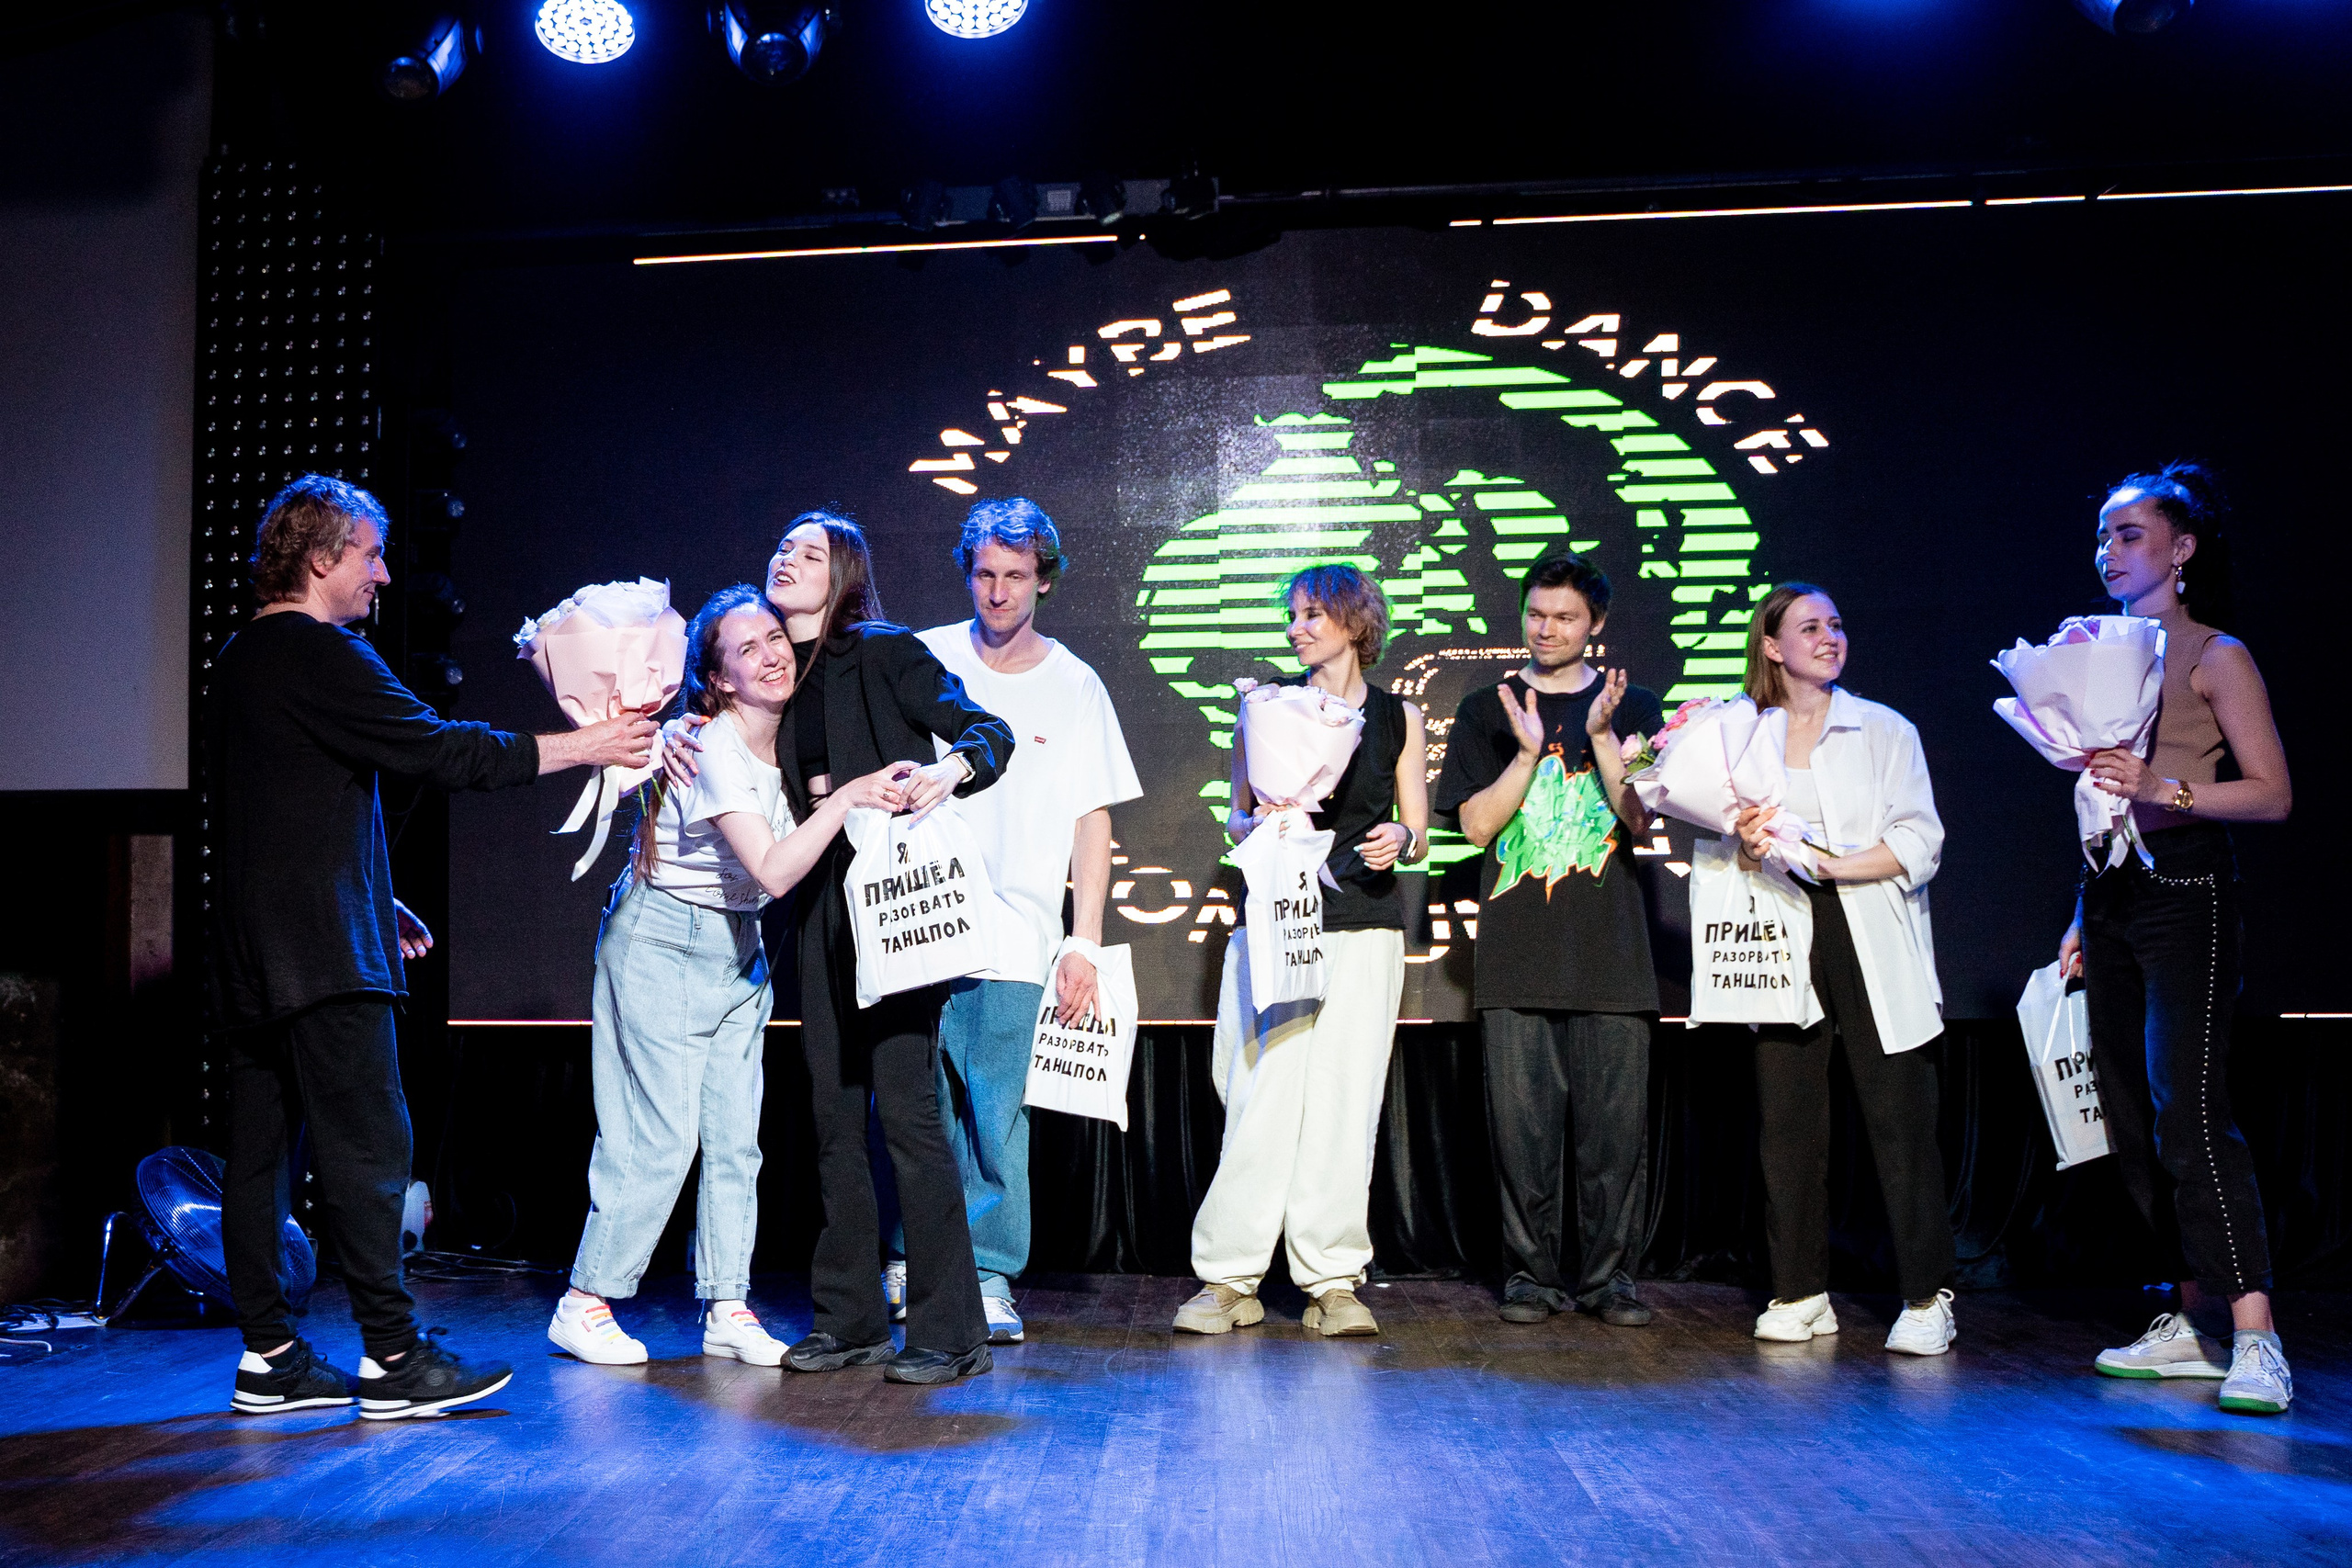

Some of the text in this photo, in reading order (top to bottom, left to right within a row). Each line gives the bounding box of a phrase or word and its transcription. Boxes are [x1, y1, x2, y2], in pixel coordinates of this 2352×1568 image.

[897, 841, 910, 864] Я
[879, 889, 966, 927] РЗОРВАТЬ
[881, 917, 971, 954] ТАНЦПОЛ
[1712, 973, 1792, 989] ТАНЦПОЛ
[1035, 1054, 1108, 1082] ТАНЦПОЛ
